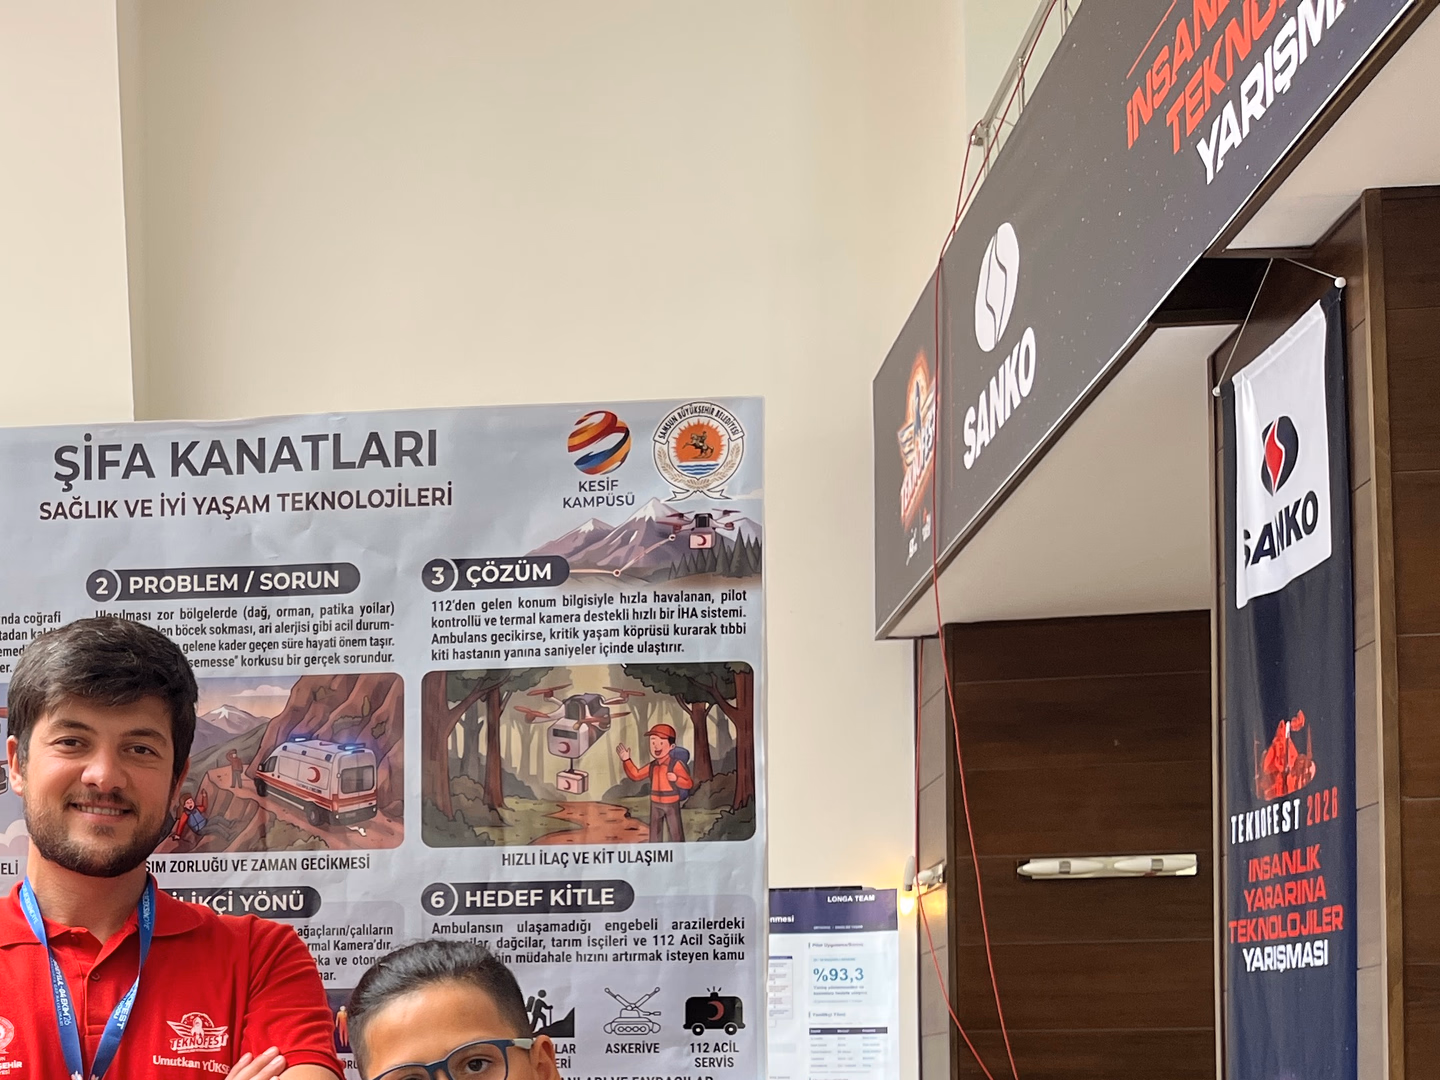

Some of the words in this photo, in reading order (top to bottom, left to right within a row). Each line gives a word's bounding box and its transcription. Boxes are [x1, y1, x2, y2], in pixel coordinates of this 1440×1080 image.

[1166, 0, 1286, 154] TEKNO
[963, 327, 1036, 470] SANKO
[658, 416, 678, 439] SAMSUN
[54, 432, 156, 492] ŞİFA
[171, 428, 439, 477] KANATLARI
[40, 495, 118, 521] SAĞLIK
[124, 500, 153, 519] VE
[159, 492, 187, 517] İYİ
[193, 495, 270, 520] YAŞAM
[277, 481, 454, 513] TEKNOLOJİLERİ
[563, 492, 634, 508] KAMPÜSÜ
[95, 577, 109, 595] 2
[129, 574, 239, 595] PROBLEM
[259, 570, 341, 592] SORUN
[432, 567, 445, 585] 3
[466, 560, 552, 589] ÇÖZÜM
[481, 598, 512, 613] gelen
[518, 596, 556, 609] konum
[562, 593, 614, 609] bilgisiyle
[620, 592, 647, 605] hızla
[653, 592, 715, 605] havalanan,
[721, 589, 747, 605] pilot
[23, 612, 61, 628] coğrafi
[157, 610, 174, 621] zor
[180, 607, 238, 623] bölgelerde
[243, 605, 271, 622] (dağ,
[276, 608, 315, 621] orman,
[320, 604, 354, 620] patika
[1230, 798, 1301, 844] TEKNOFEST
[1306, 786, 1338, 827] 2026
[0, 859, 19, 875] ELİ
[169, 856, 228, 873] ZORLUĞU
[231, 858, 248, 872] VE
[251, 857, 297, 872] ZAMAN
[301, 853, 371, 871] GECİKMESİ
[502, 853, 535, 867] HIZLI
[539, 849, 569, 868] İLAÇ
[572, 851, 590, 865] VE
[593, 848, 615, 864] KİT
[618, 849, 674, 867] ULAŞIMI
[239, 890, 303, 911] YÖNÜ
[431, 891, 445, 908] 6
[465, 889, 543, 908] HEDEF
[550, 883, 615, 907] KİTLE
[855, 894, 875, 902] TEAM
[1244, 876, 1326, 913] YARARINA
[432, 921, 503, 934] Ambulansın
[517, 920, 591, 935] ulaşamadığı
[605, 918, 658, 933] engebeli
[672, 917, 745, 931] arazilerdeki
[515, 950, 572, 964] müdahale
[576, 950, 609, 964] hızını
[612, 949, 663, 963] artırmak
[666, 949, 709, 965] isteyen
[712, 949, 745, 962] kamu
[1242, 939, 1329, 973] YARIŞMASI
[812, 967, 864, 984] %93,3
[170, 1032, 228, 1053] TEKNOFEST
[605, 1041, 660, 1055] ASKERİVE
[689, 1042, 710, 1054] 112
[713, 1039, 740, 1054] ACİL
[153, 1054, 200, 1070] Umutkan
[694, 1055, 735, 1069] SERVİS
